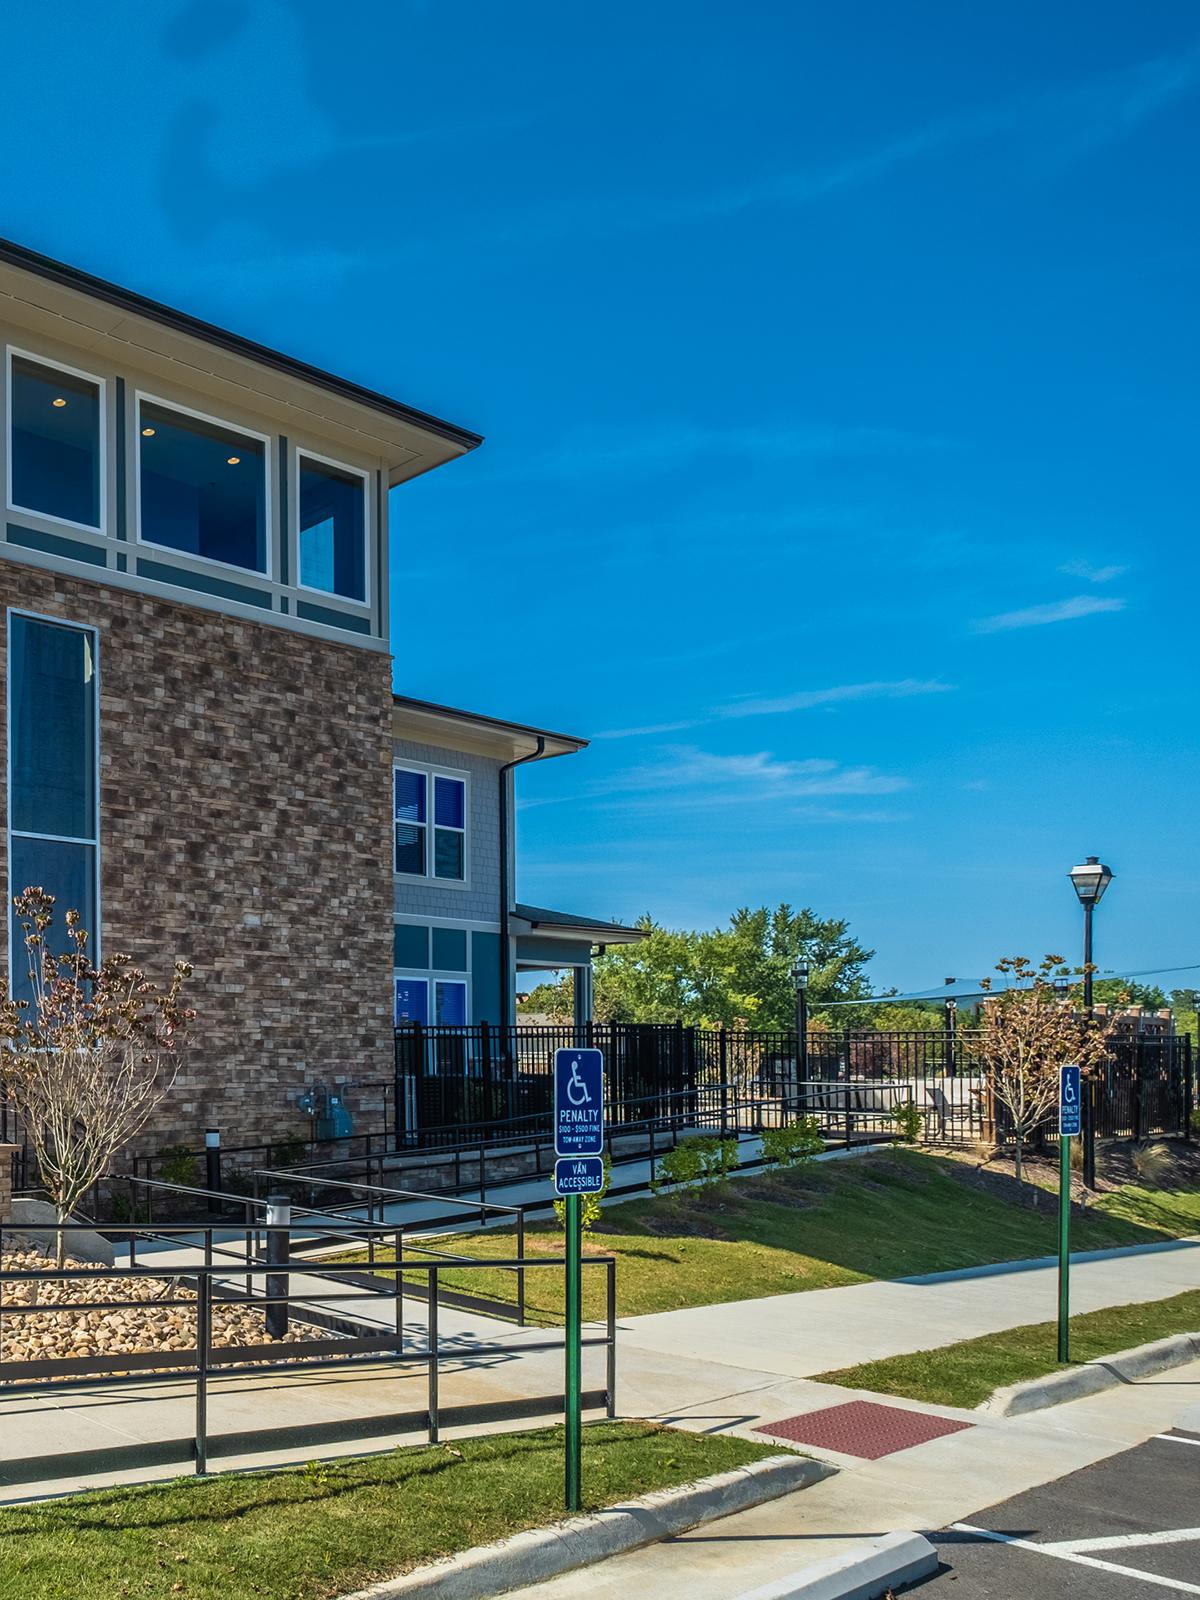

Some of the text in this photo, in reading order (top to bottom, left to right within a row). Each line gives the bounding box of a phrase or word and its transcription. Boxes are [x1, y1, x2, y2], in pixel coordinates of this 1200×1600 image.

[560, 1110, 598, 1122] PENALTY
[559, 1125, 571, 1133] $100
[575, 1124, 588, 1133] $500
[589, 1124, 600, 1132] FINE
[572, 1164, 587, 1174] VAN
[559, 1176, 600, 1189] ACCESSIBLE
